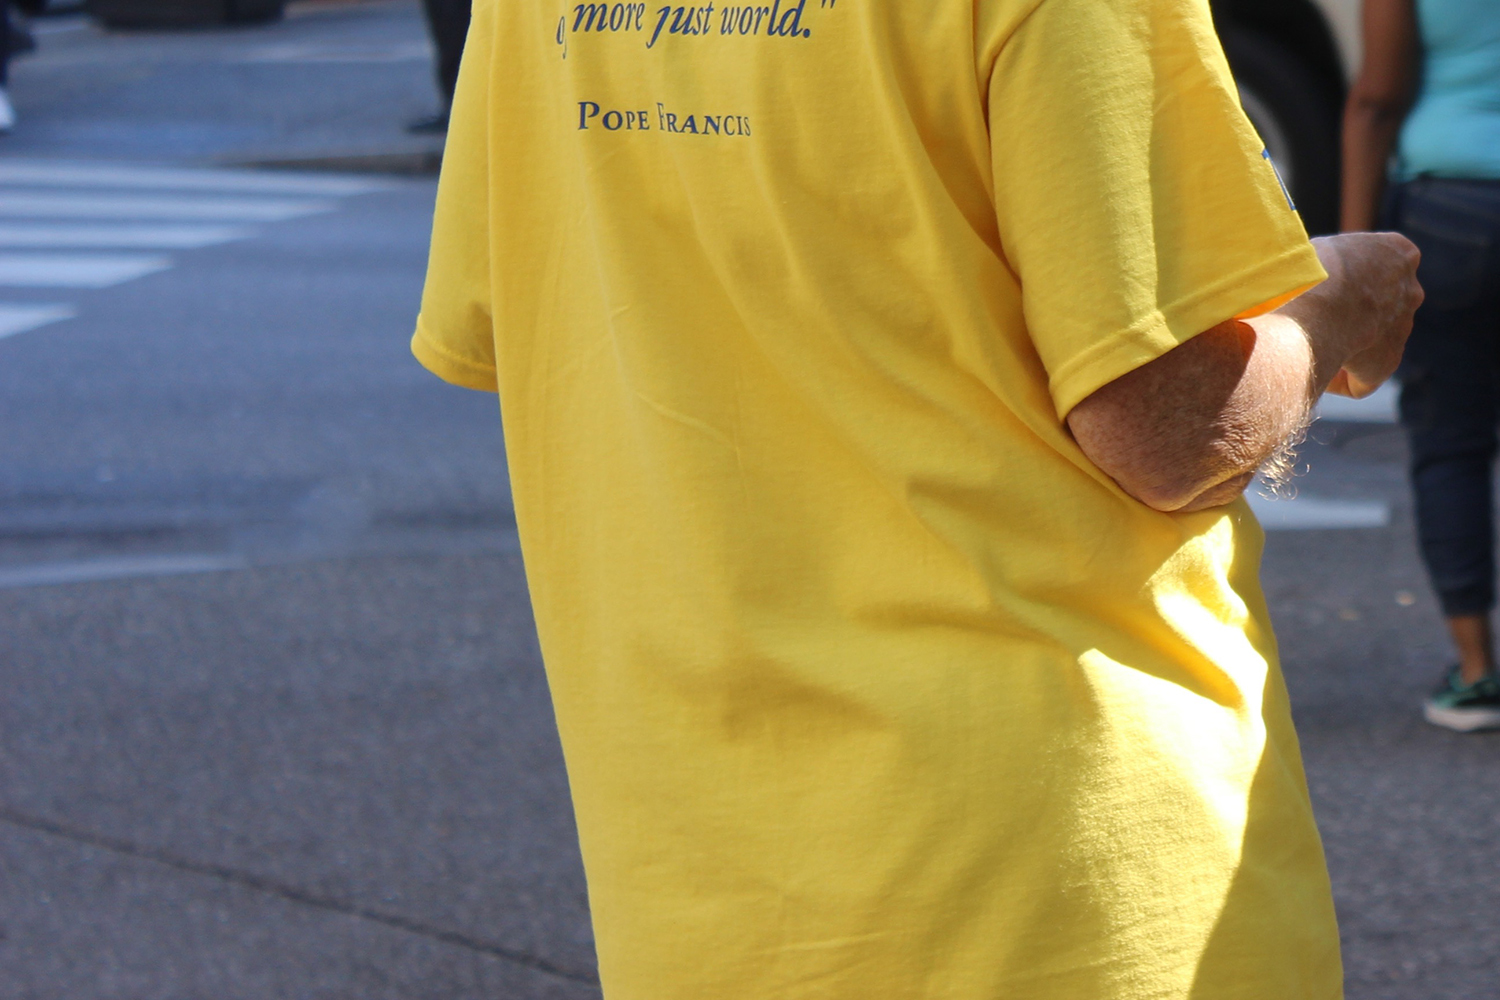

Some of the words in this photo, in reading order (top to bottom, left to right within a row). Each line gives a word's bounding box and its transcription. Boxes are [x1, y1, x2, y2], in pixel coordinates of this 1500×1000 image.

[572, 2, 646, 33] more
[578, 101, 650, 131] POPE
[656, 102, 751, 137] FRANCIS
